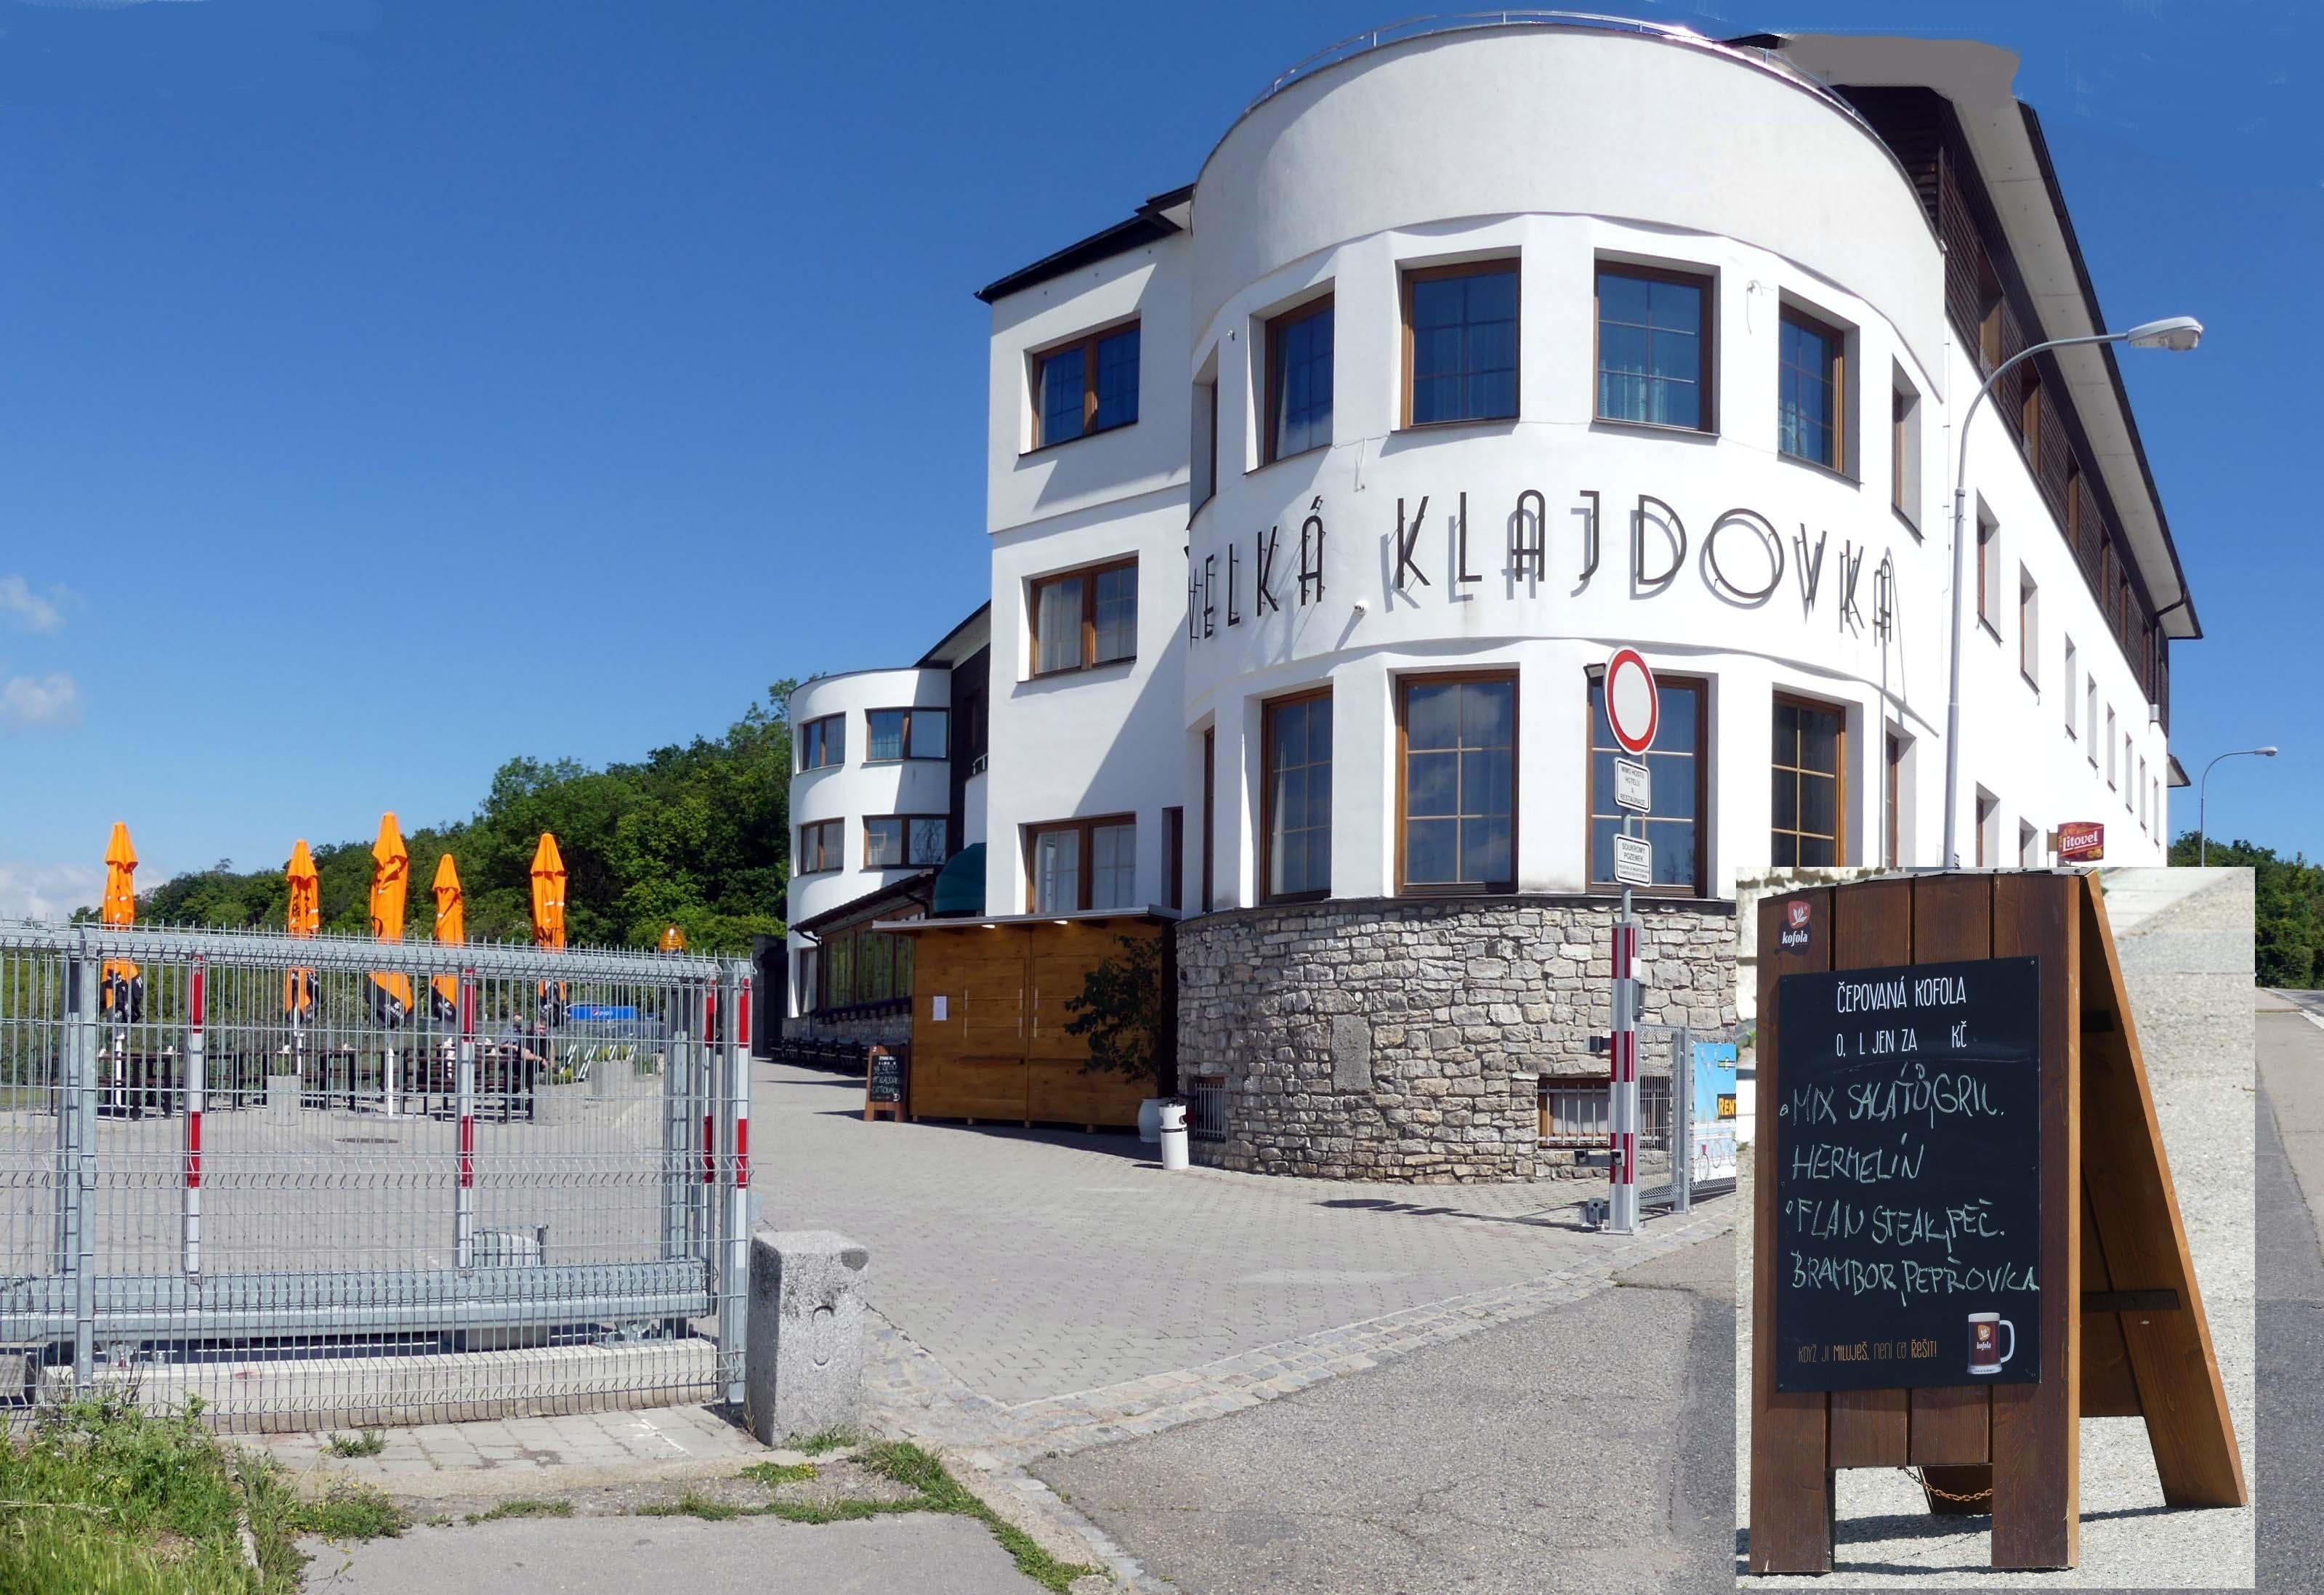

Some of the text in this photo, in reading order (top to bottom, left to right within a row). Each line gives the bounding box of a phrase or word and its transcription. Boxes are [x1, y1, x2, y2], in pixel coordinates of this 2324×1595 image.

[1184, 490, 1892, 651] VELKÁ KLAJDOVKA
[2063, 831, 2099, 852] Litovel
[1781, 930, 1809, 947] kofola
[1837, 975, 1966, 1013] ČEPOVANÁ KOFOLA
[1860, 1032, 1865, 1055] L
[1872, 1030, 1895, 1054] JEN
[1901, 1028, 1918, 1052] ZA
[1952, 1020, 1966, 1049] KČ
[1793, 1083, 1837, 1126] MIX
[1793, 1134, 1924, 1183] HERMELÍN
[1799, 1344, 1817, 1363] KDYŽ
[1822, 1345, 1829, 1362] JI
[1976, 1341, 1991, 1351] kofola
